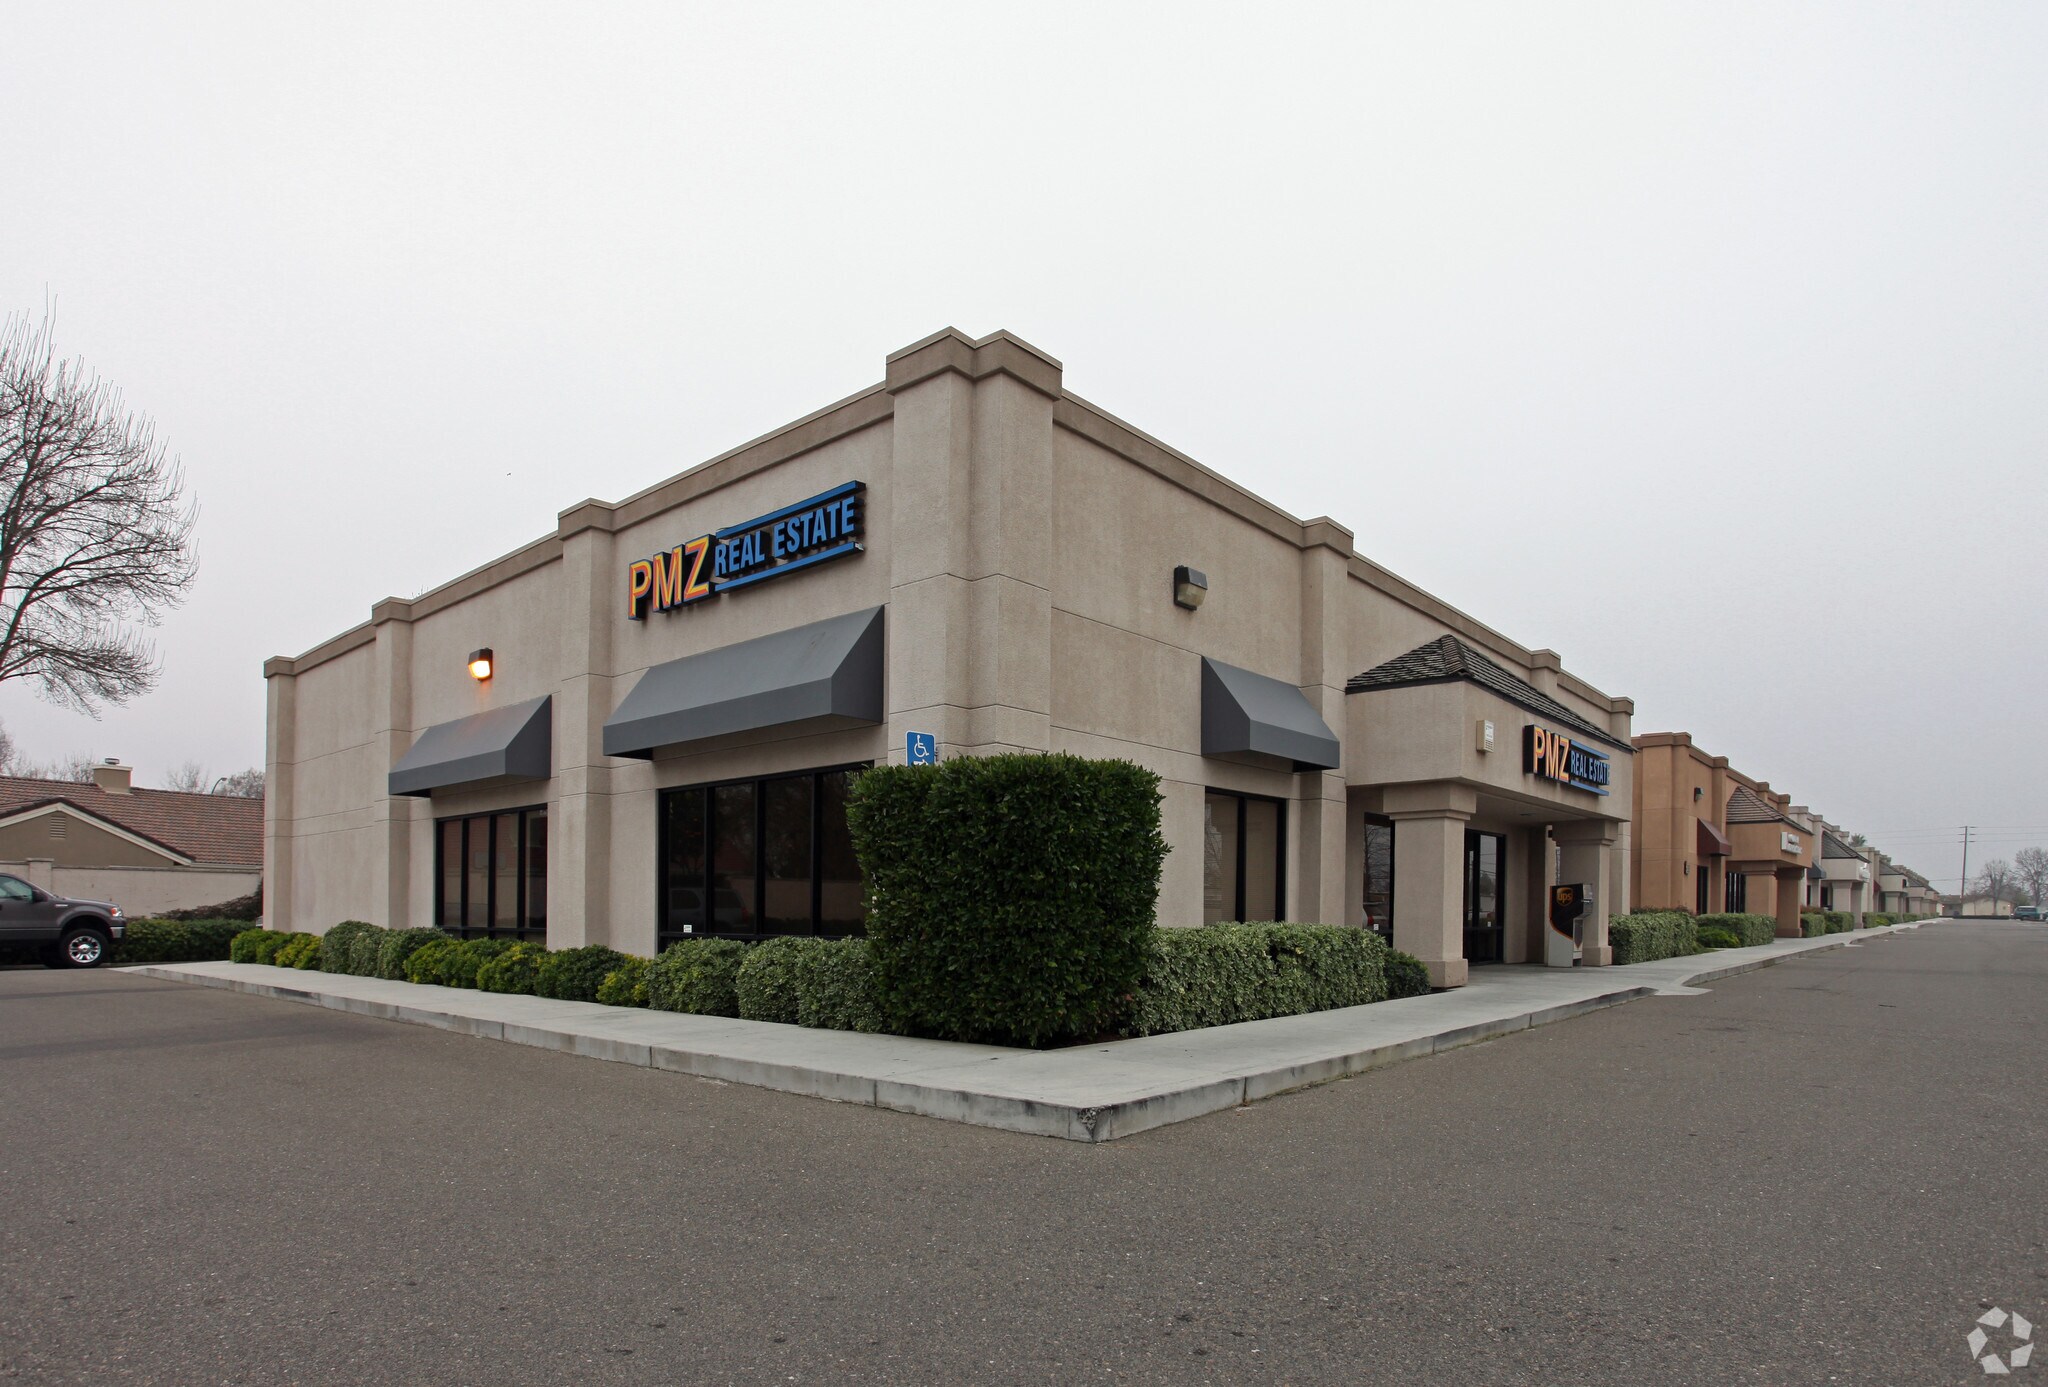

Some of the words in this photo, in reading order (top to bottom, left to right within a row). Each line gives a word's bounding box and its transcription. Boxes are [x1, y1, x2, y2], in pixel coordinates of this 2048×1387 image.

[627, 534, 712, 620] PMZ
[714, 531, 766, 577] REAL
[773, 496, 856, 557] ESTATE
[1532, 725, 1570, 783] PMZ
[1570, 750, 1588, 778] REAL
[1589, 757, 1610, 785] ESTATE
